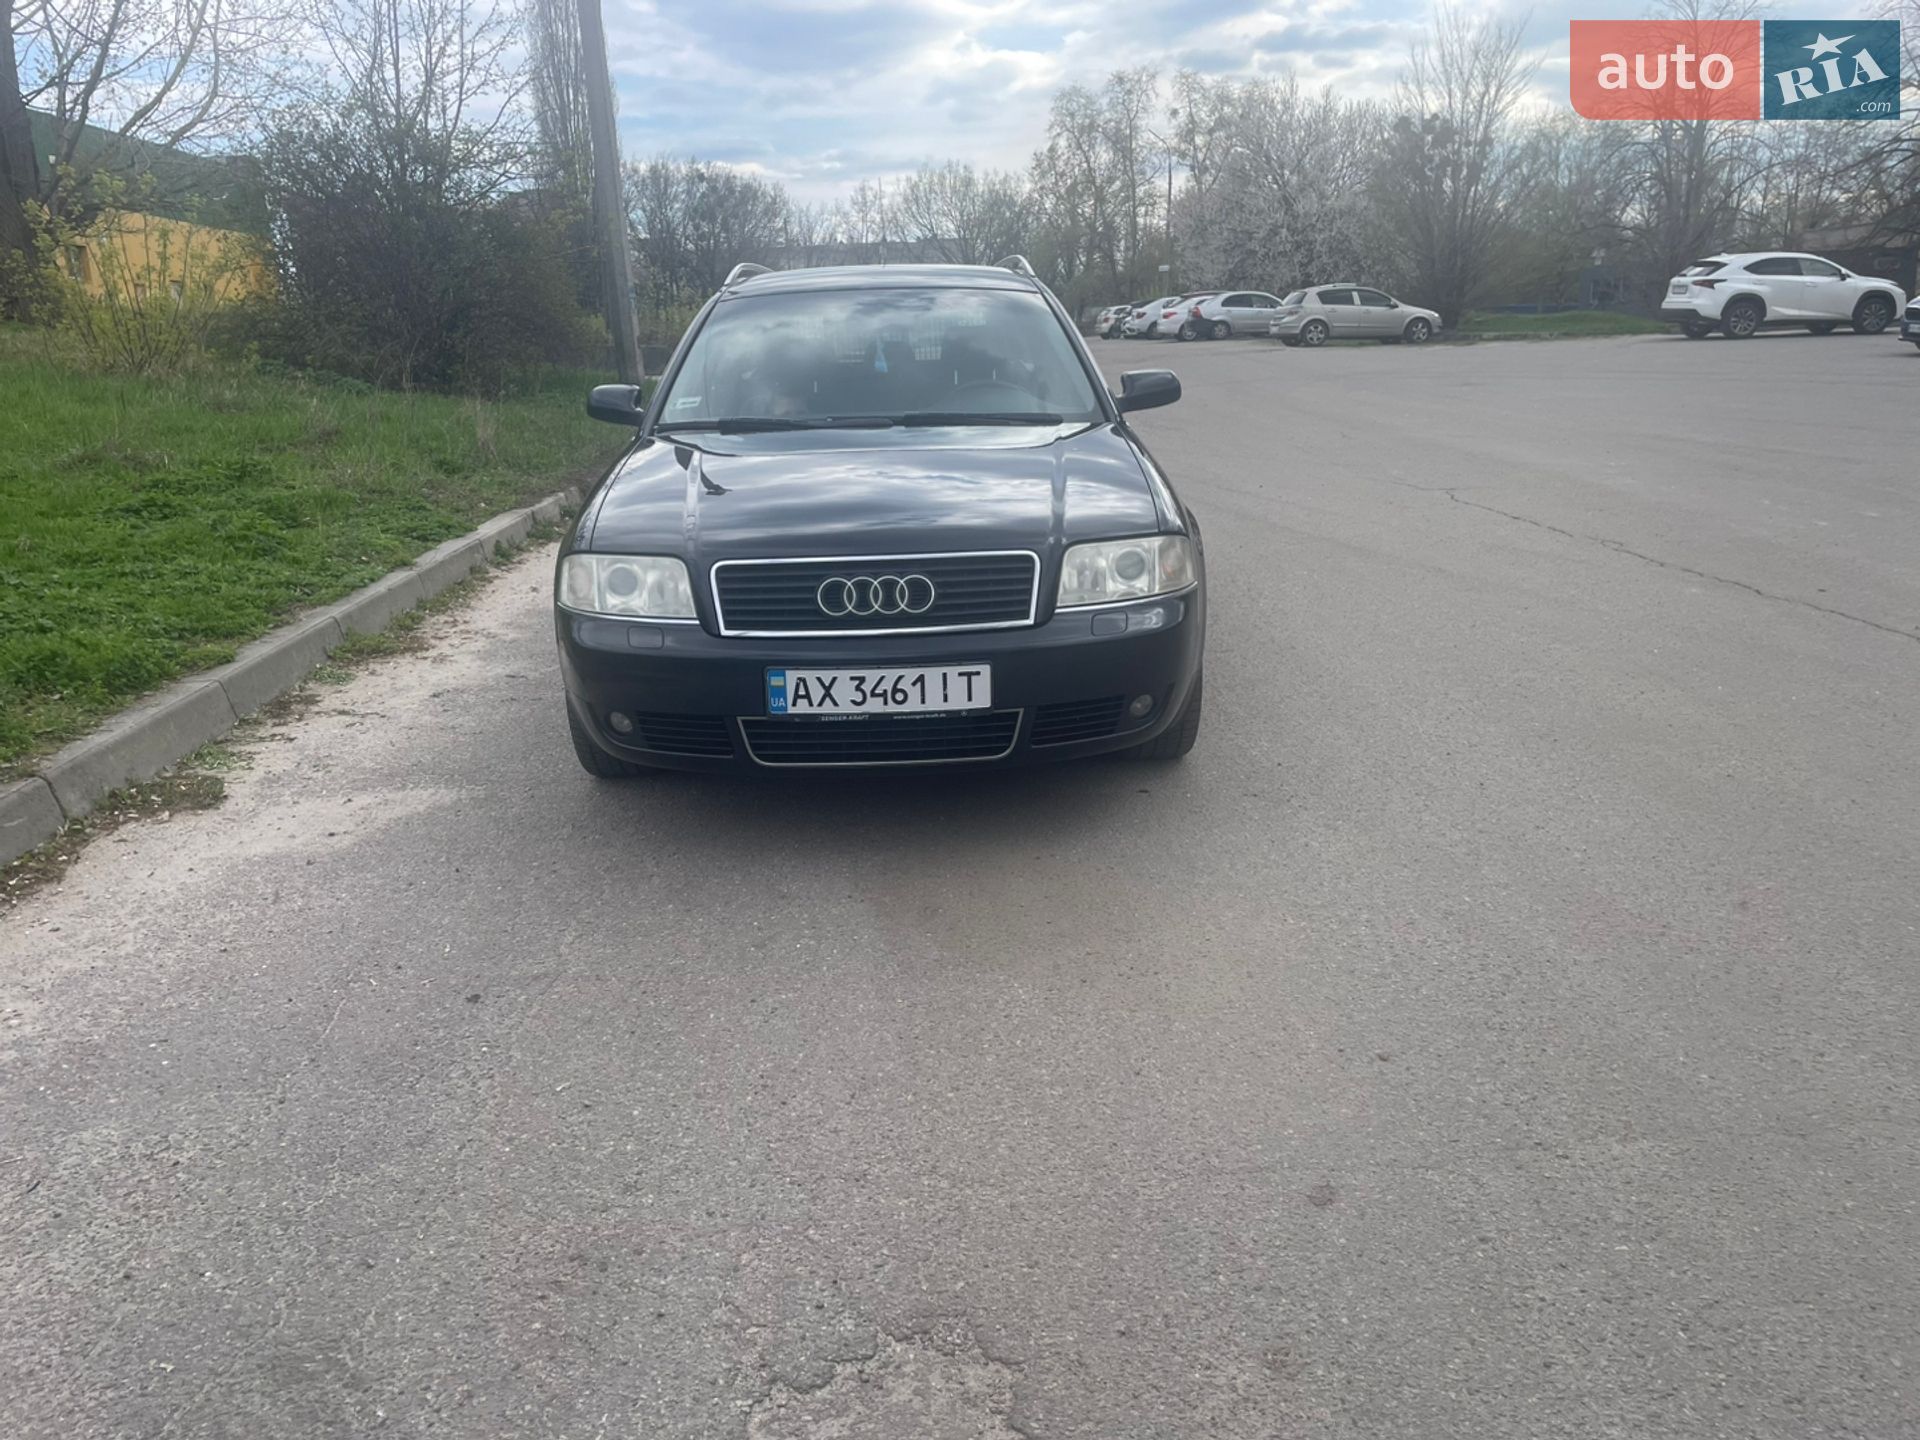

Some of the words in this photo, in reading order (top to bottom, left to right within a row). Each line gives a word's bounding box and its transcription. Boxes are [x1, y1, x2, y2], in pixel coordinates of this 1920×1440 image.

[791, 676, 840, 707] AX
[849, 673, 926, 706] 3461
[942, 671, 981, 703] IT
[770, 697, 786, 707] UA
